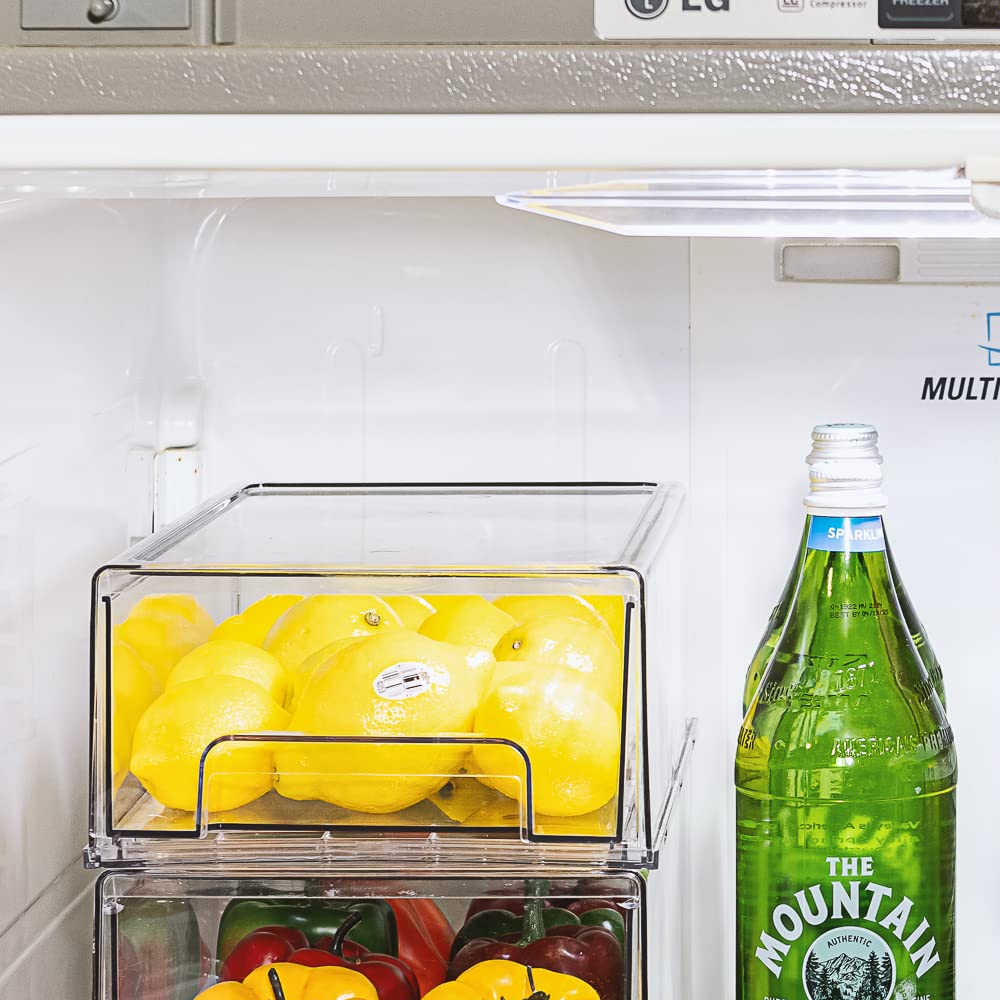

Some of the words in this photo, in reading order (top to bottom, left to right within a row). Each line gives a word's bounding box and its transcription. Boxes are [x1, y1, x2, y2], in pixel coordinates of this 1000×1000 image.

[825, 856, 874, 877] THE
[755, 881, 941, 979] MOUNTAIN
[827, 935, 872, 949] AUTHENTIC
